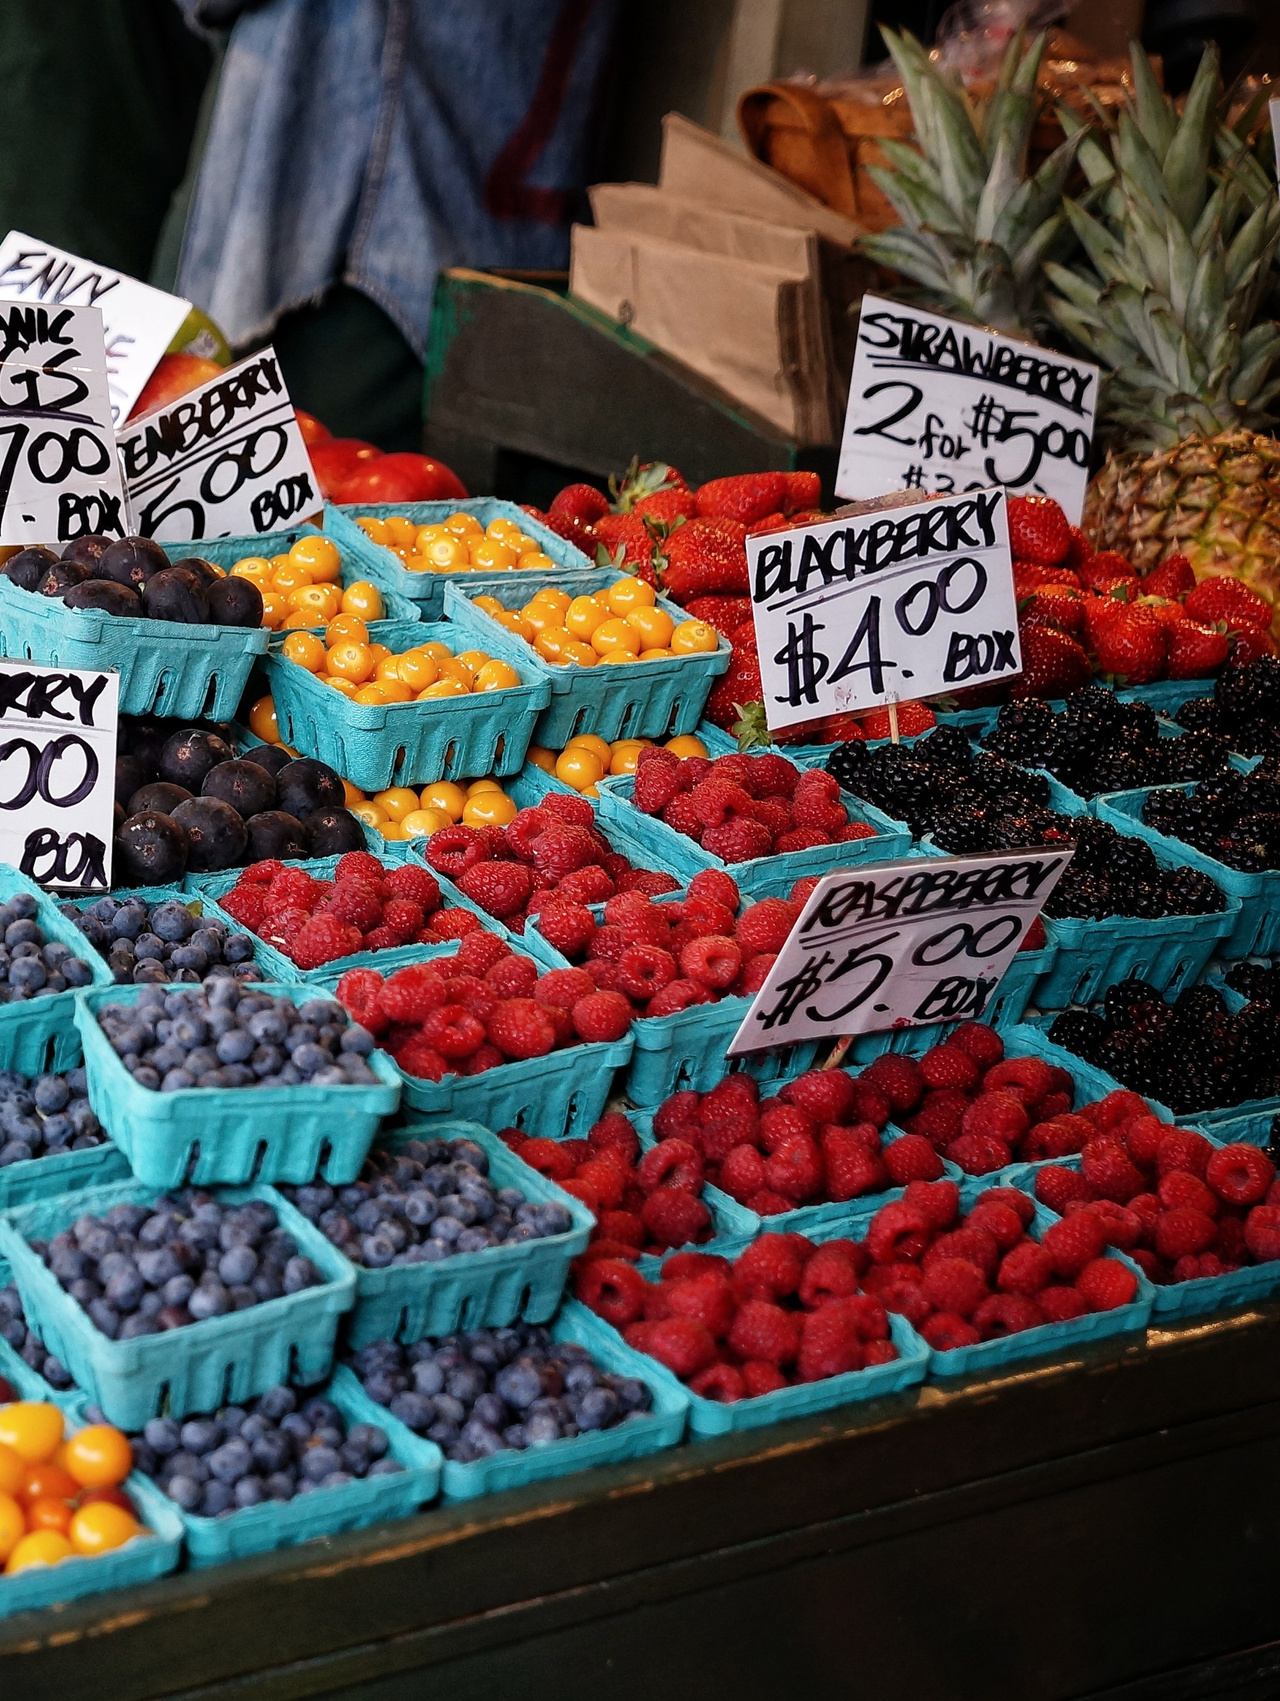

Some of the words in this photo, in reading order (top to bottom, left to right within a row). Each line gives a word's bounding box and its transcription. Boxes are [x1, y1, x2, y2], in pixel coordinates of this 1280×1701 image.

[860, 312, 1093, 412] STRAWBERRY
[116, 358, 282, 478] ENBERRY
[854, 381, 923, 446] 2
[919, 413, 970, 460] for
[58, 489, 126, 542] BOX
[251, 472, 315, 532] BOX
[754, 489, 1003, 603] BLACKBERRY
[944, 630, 1017, 684] BOX
[20, 827, 108, 887] BOX
[799, 856, 1063, 933] RASPBERRY
[913, 976, 998, 1020] BOX
